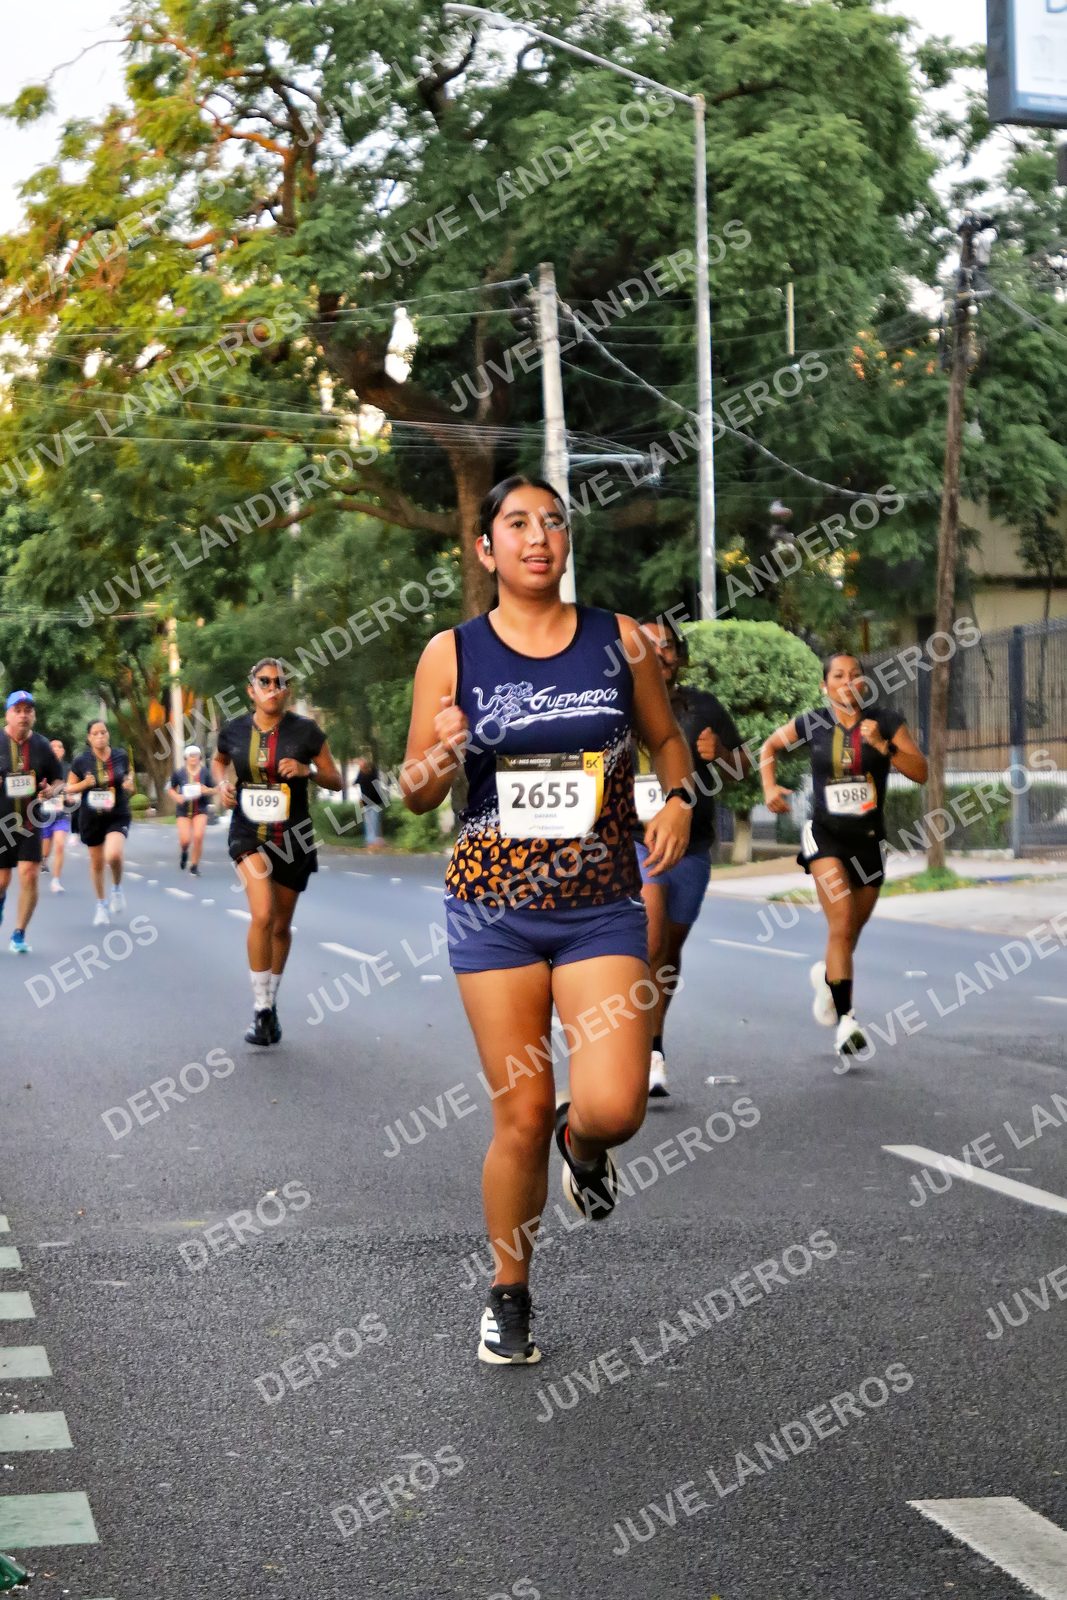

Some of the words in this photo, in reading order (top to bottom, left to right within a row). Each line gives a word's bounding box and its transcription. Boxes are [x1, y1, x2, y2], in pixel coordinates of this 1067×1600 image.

[523, 685, 619, 711] GUEPARDOS
[249, 794, 280, 807] 1699
[511, 782, 579, 808] 2655
[834, 787, 868, 803] 1988
